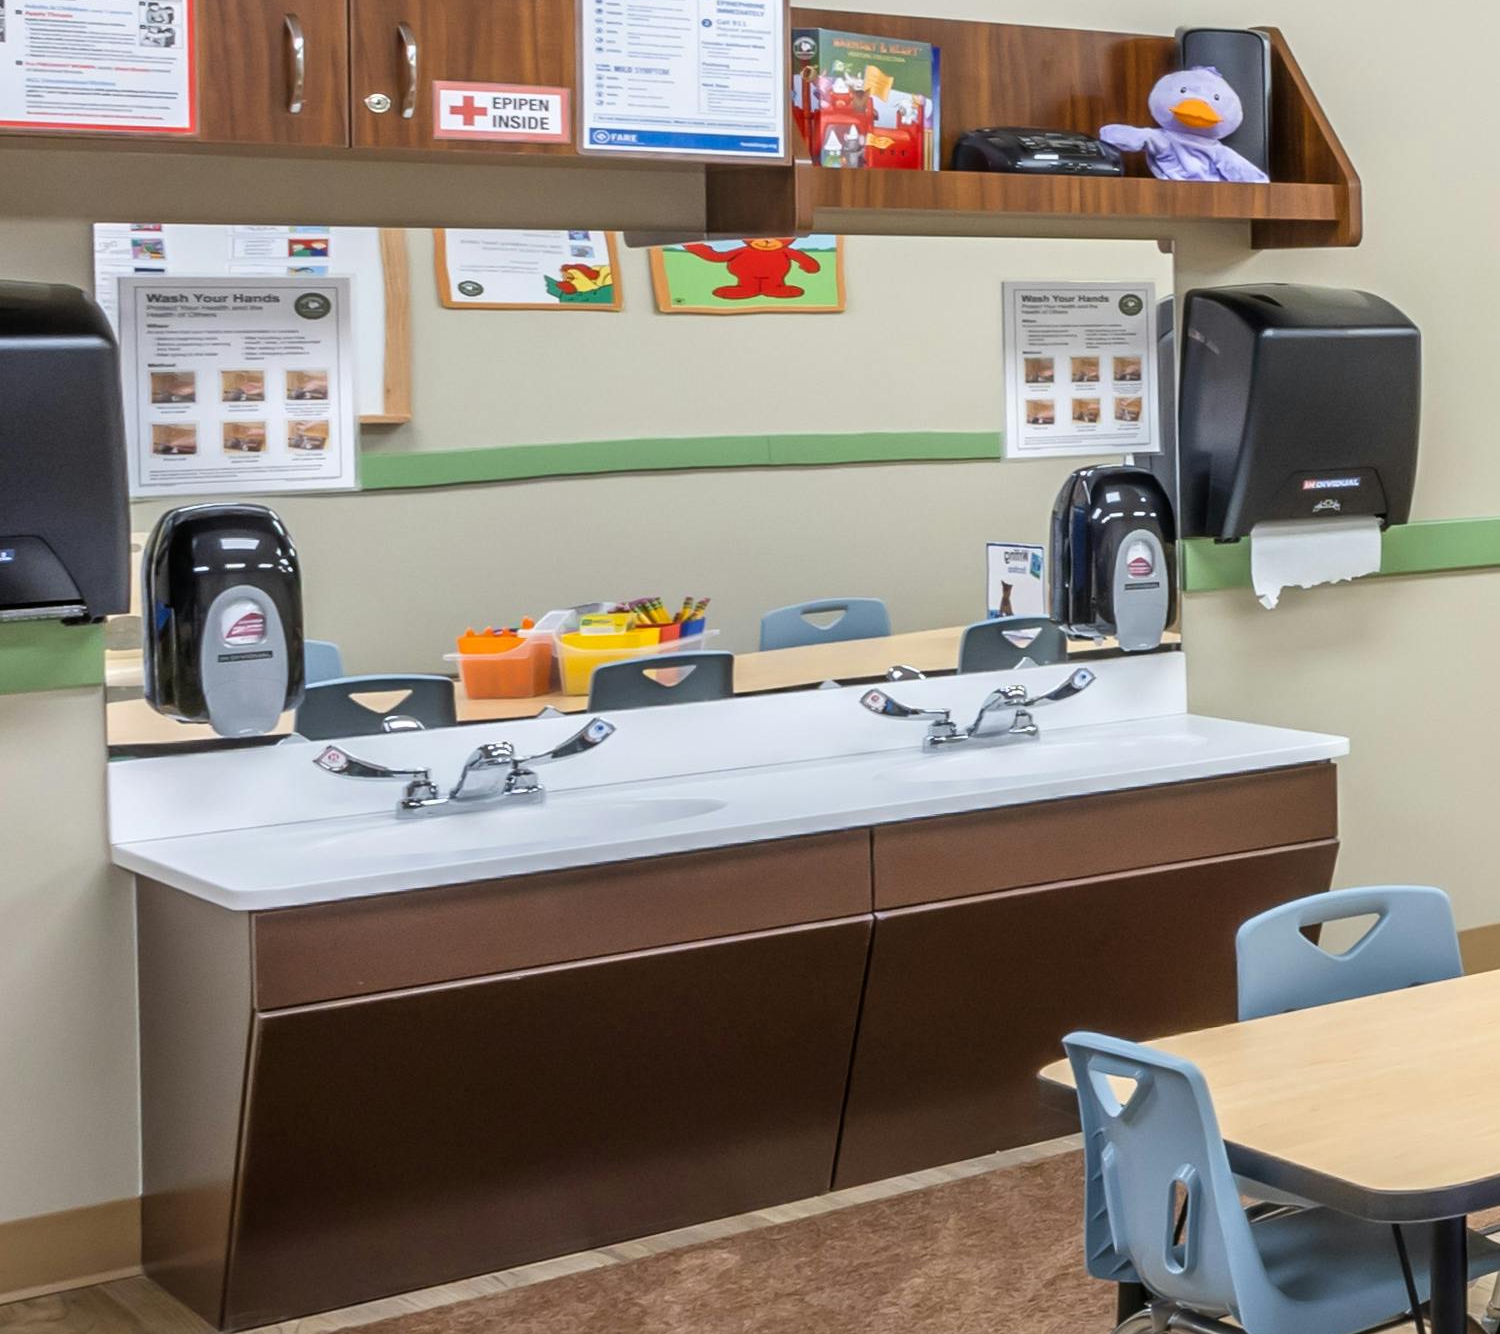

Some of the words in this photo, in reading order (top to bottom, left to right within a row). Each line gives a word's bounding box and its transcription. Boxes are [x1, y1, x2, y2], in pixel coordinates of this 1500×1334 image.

[492, 96, 550, 112] EPIPEN
[492, 115, 550, 130] INSIDE
[610, 131, 638, 143] FARE
[146, 293, 189, 304] Wash
[193, 293, 229, 304] Your
[233, 293, 280, 304] Hands
[1021, 295, 1050, 303] Wash
[1052, 295, 1075, 303] Your
[1078, 295, 1110, 303] Hands
